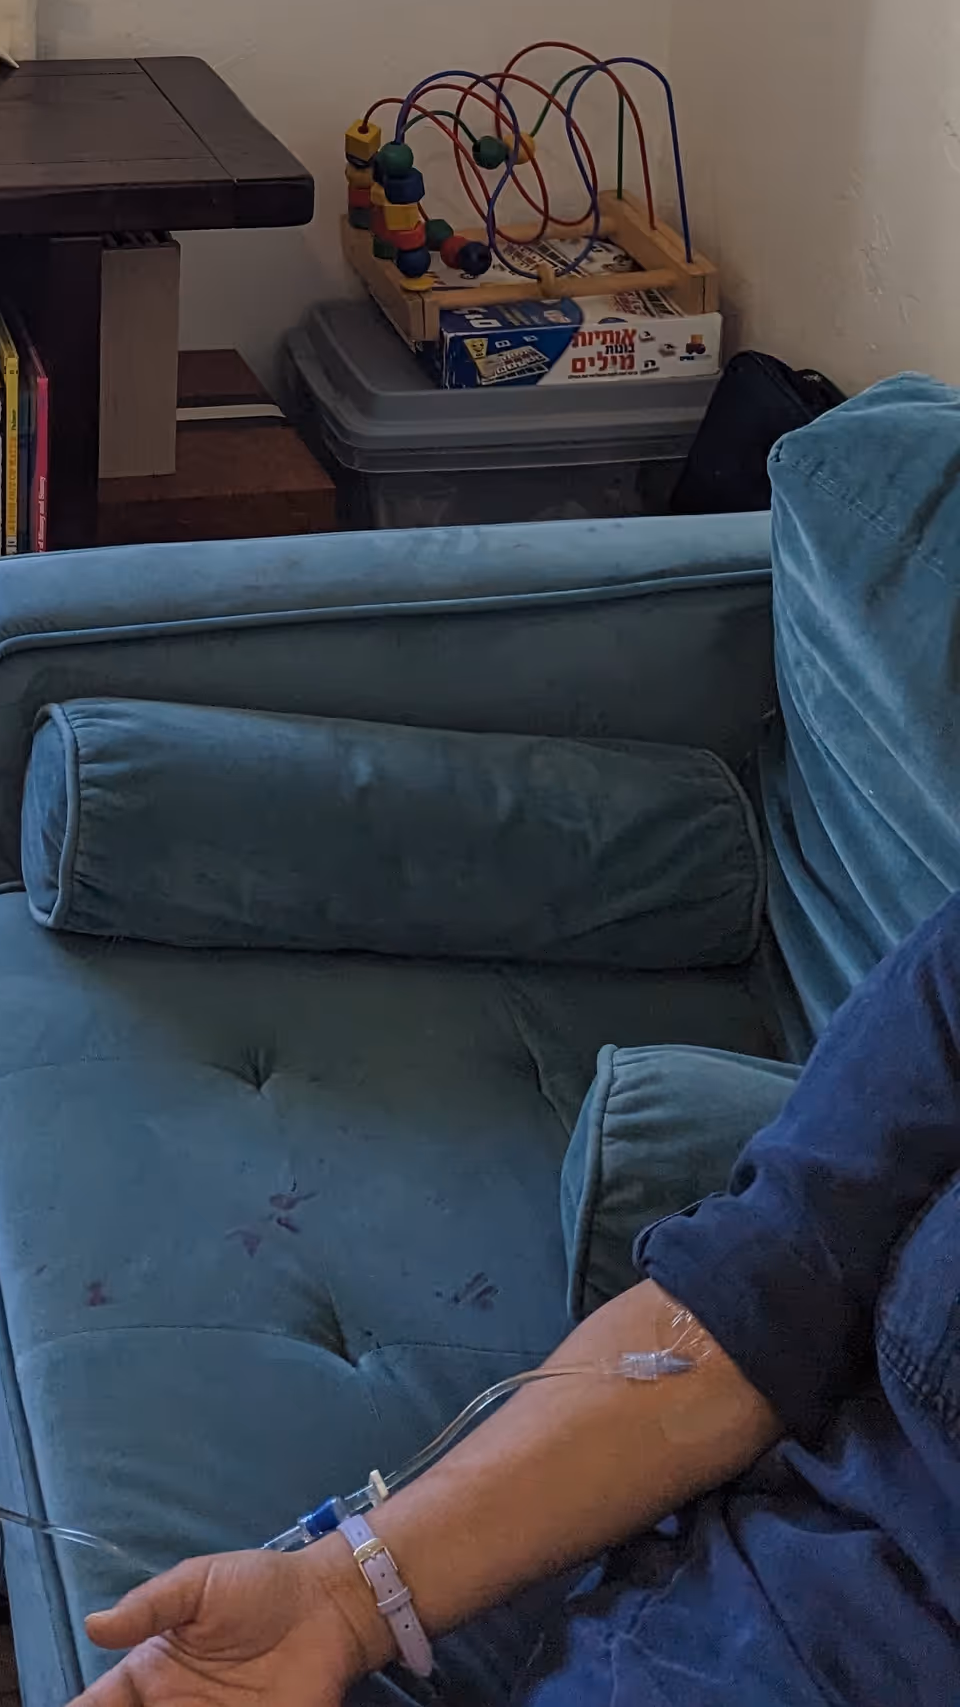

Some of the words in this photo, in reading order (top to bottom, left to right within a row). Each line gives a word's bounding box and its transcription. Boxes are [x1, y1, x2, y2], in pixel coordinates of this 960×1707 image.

[572, 329, 637, 348] אותיות
[605, 343, 635, 355] בונות
[572, 352, 635, 373] מילים
